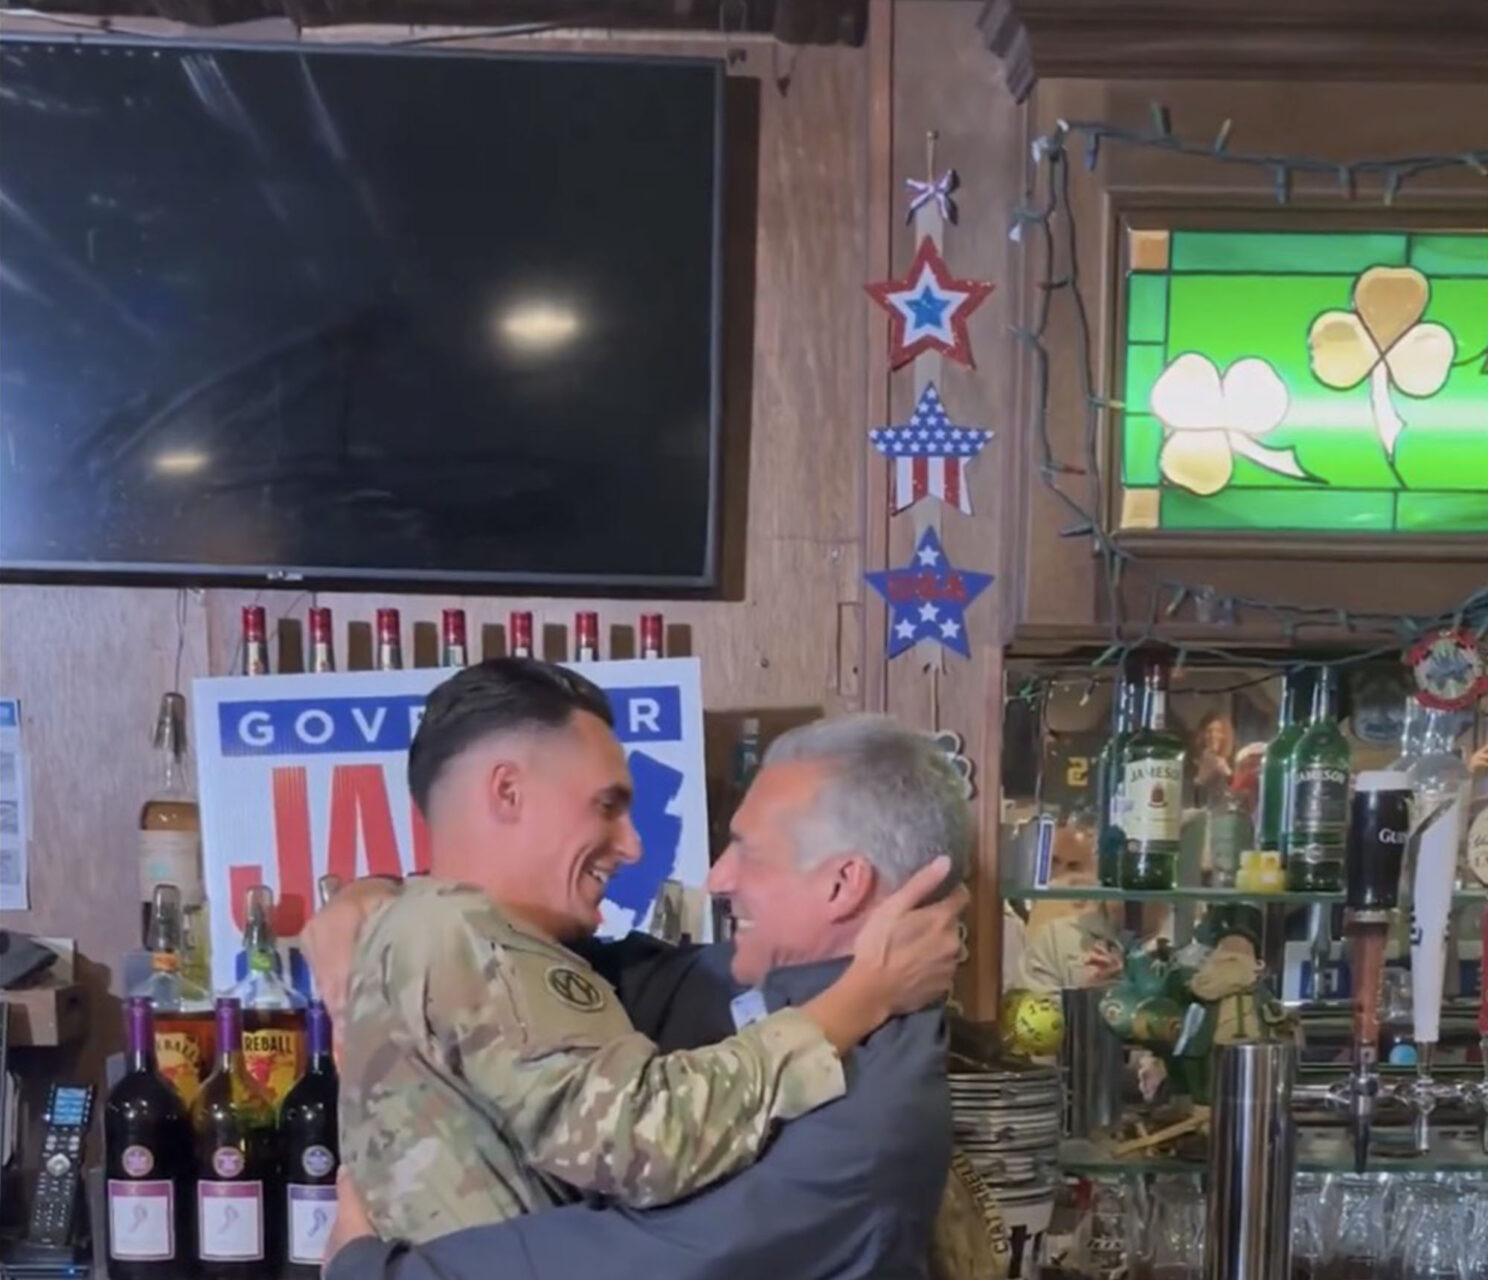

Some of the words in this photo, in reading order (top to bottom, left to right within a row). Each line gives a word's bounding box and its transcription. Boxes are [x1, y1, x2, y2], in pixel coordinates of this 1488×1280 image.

[238, 697, 660, 746] GOVR
[229, 763, 436, 938] JA
[243, 1034, 293, 1054] REBALL
